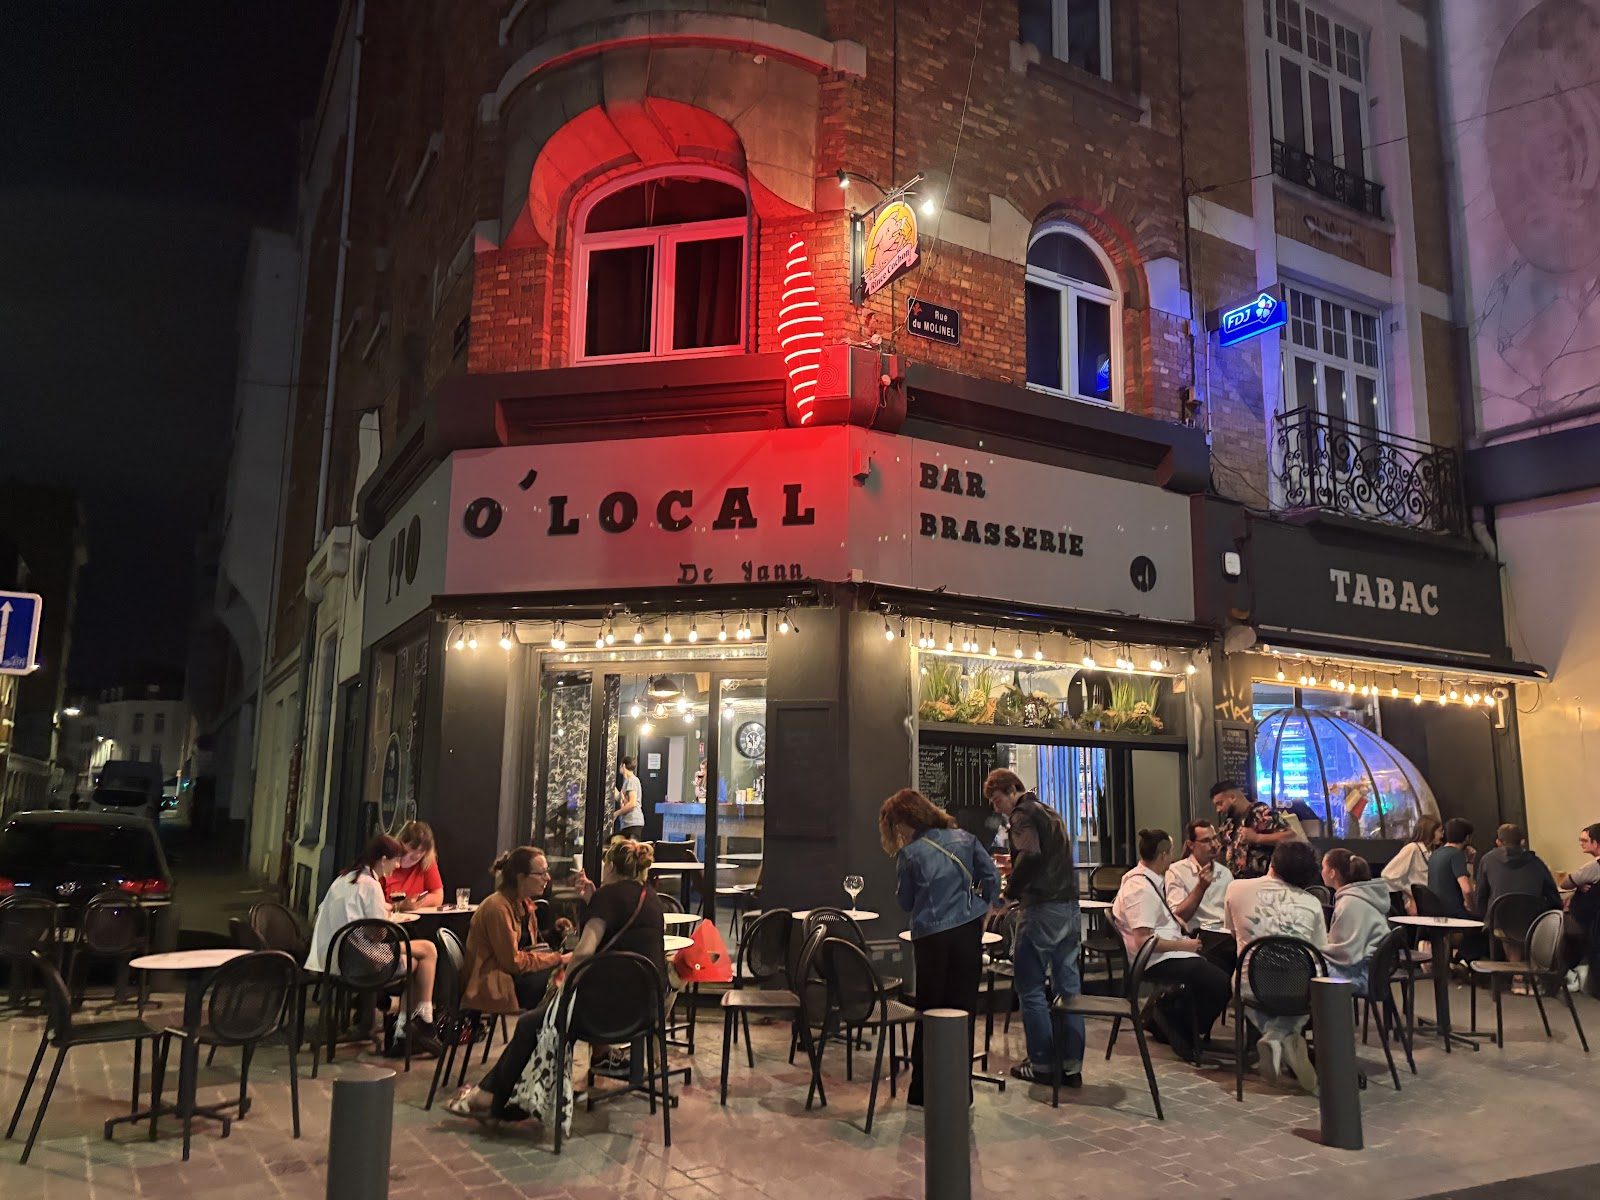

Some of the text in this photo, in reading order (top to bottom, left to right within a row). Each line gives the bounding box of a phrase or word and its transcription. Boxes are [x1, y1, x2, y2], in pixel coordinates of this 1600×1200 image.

[887, 249, 910, 273] Cochon
[912, 318, 956, 338] du MOLINEL
[934, 310, 948, 322] Rue
[1228, 308, 1251, 329] FDJ
[919, 462, 986, 499] BAR
[919, 512, 1084, 557] BRASSERIE
[677, 560, 804, 585] De Yann
[1329, 568, 1440, 617] TABAC
